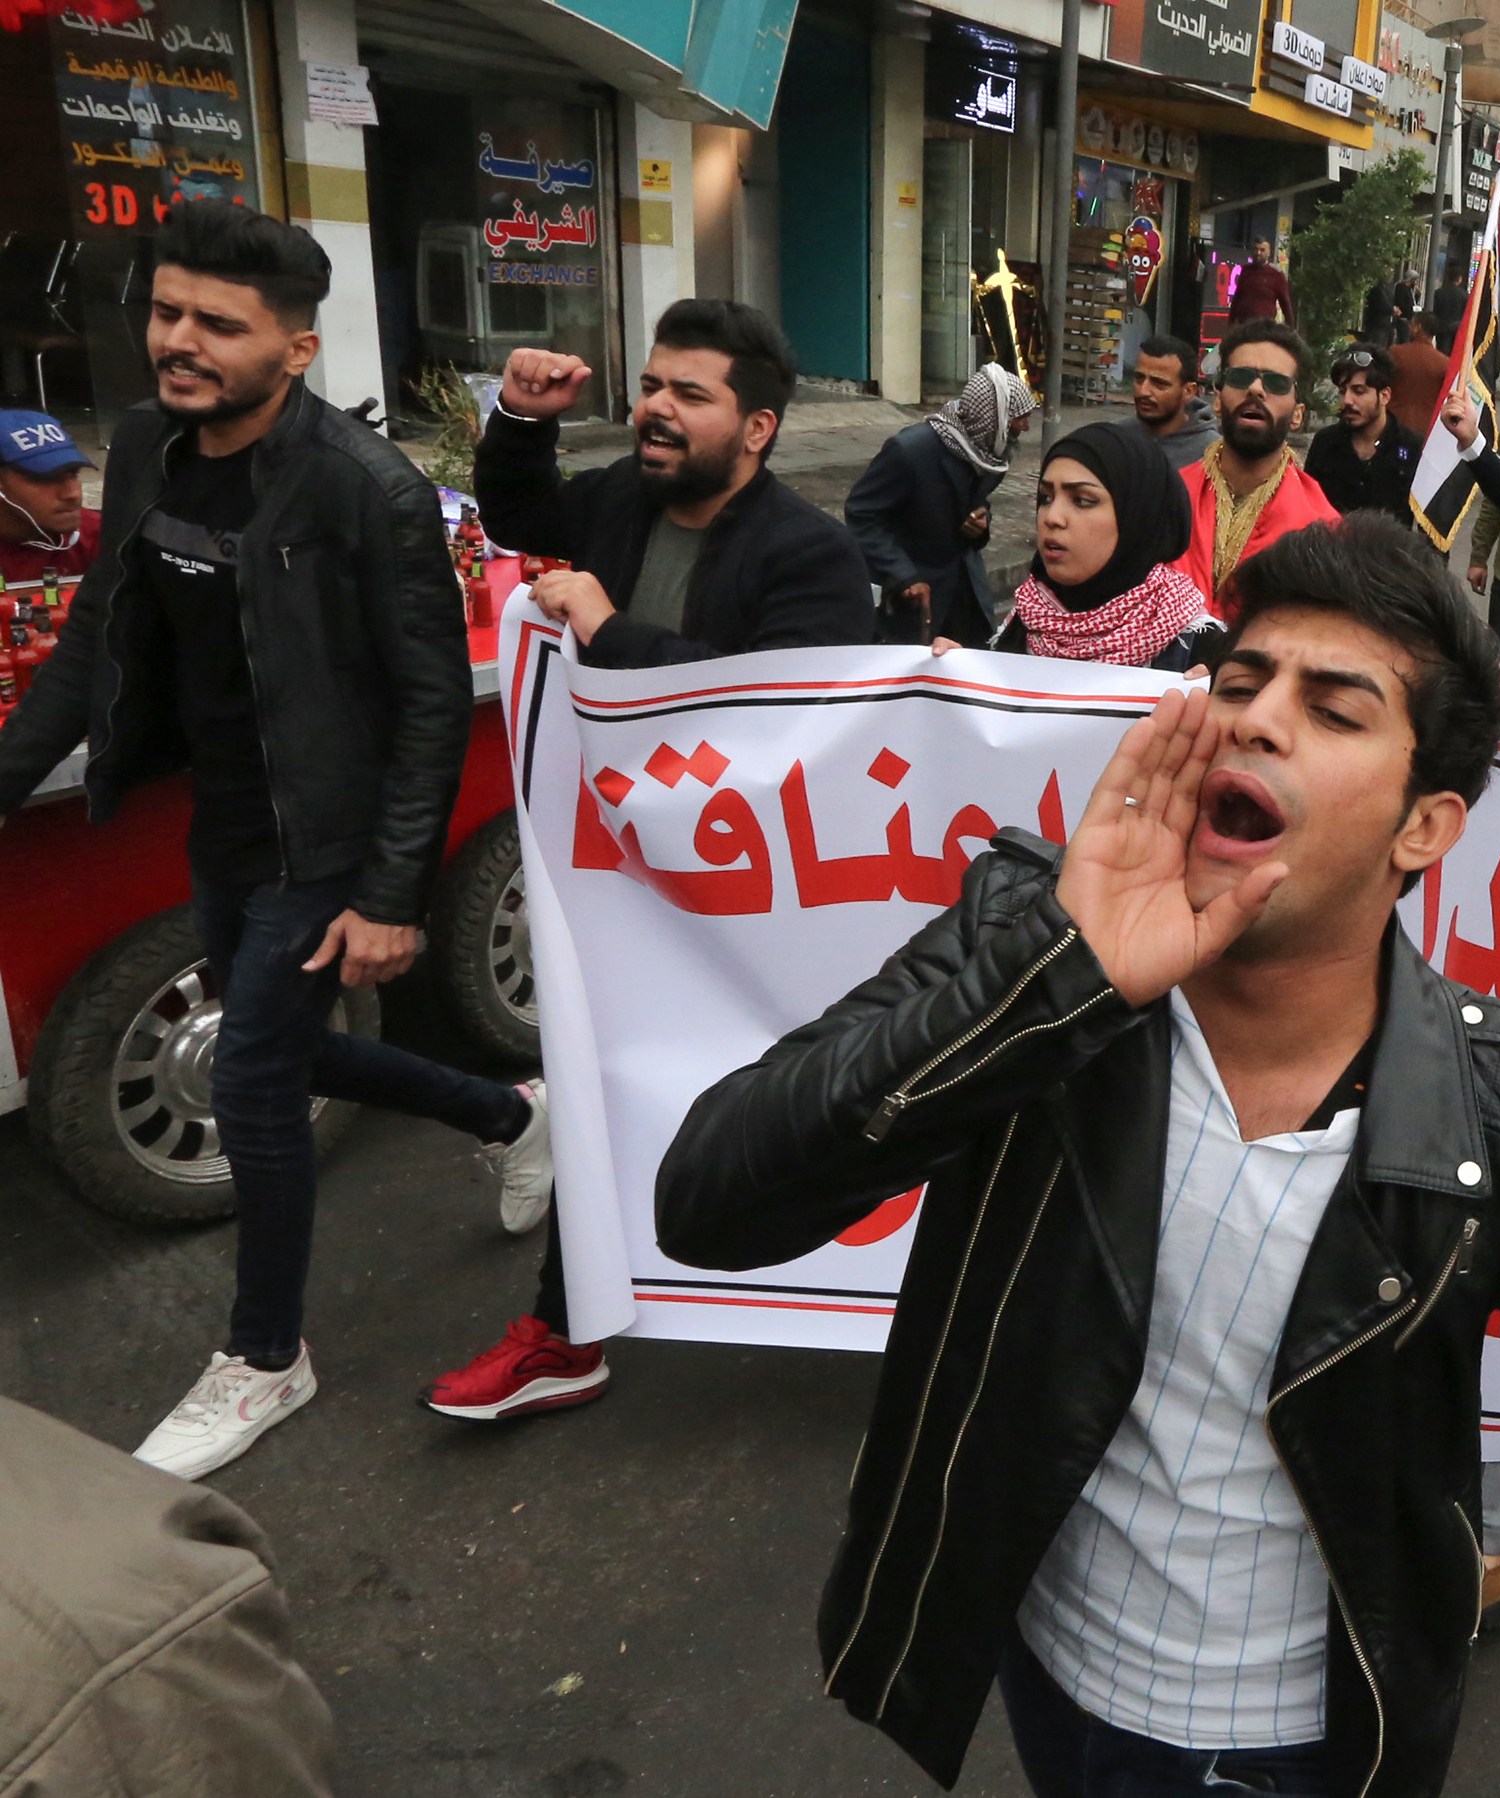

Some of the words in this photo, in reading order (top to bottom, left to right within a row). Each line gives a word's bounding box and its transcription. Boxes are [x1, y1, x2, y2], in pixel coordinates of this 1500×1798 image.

[1157, 0, 1207, 40] الحديث
[1207, 24, 1252, 57] الضوئي
[1283, 28, 1298, 54] 3D
[62, 95, 163, 127] الواجهات
[1315, 83, 1348, 113] شاشات
[167, 106, 243, 141] وتغليف
[479, 132, 594, 195] صيرفة
[86, 182, 138, 225] 3D
[484, 199, 597, 258] الشريفي
[488, 261, 598, 287] EXCHANGE
[10, 424, 65, 451] EXO
